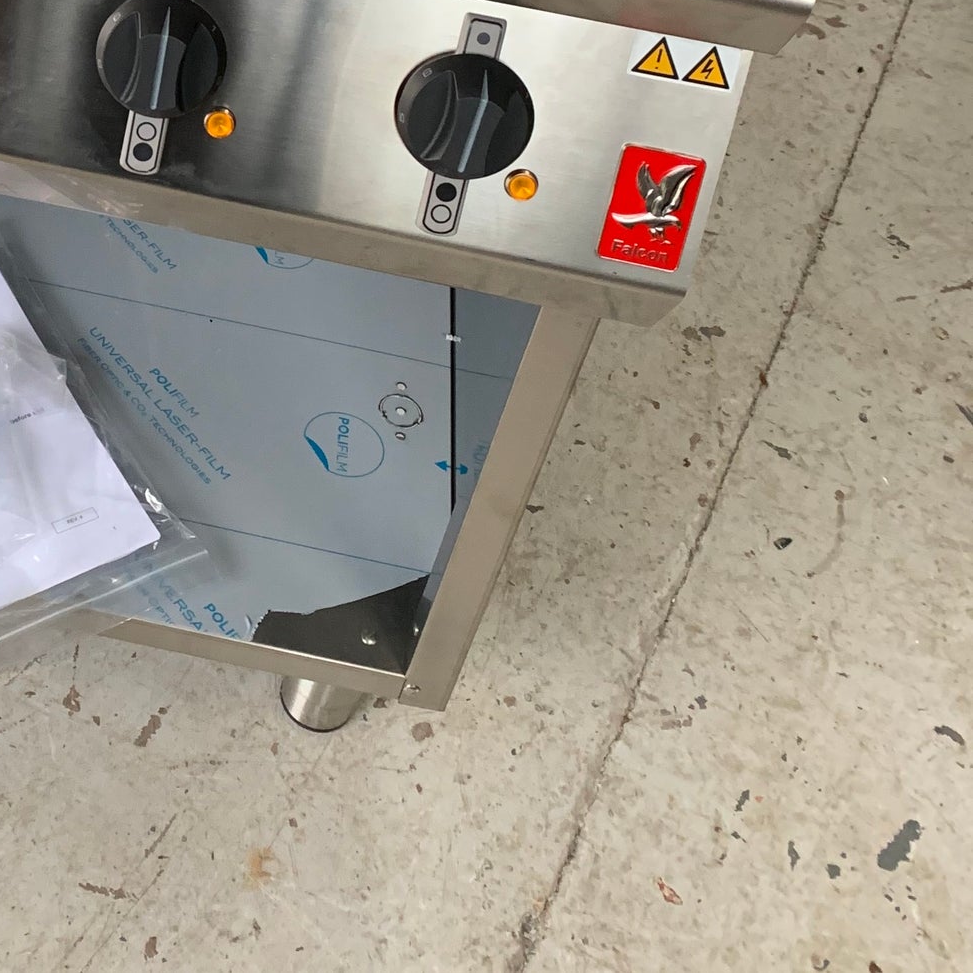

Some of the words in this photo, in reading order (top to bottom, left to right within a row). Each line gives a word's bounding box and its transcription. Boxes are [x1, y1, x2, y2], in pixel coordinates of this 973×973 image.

[611, 238, 668, 263] Falcon
[77, 337, 102, 364] FIBER
[100, 362, 125, 388] OPTIC
[149, 415, 211, 485] TECHNOLOGIES
[89, 327, 154, 399] UNIVERSAL
[154, 399, 231, 480] LASER-FILM
[149, 368, 200, 418] POLIFILM
[336, 416, 350, 473] POLIFILM
